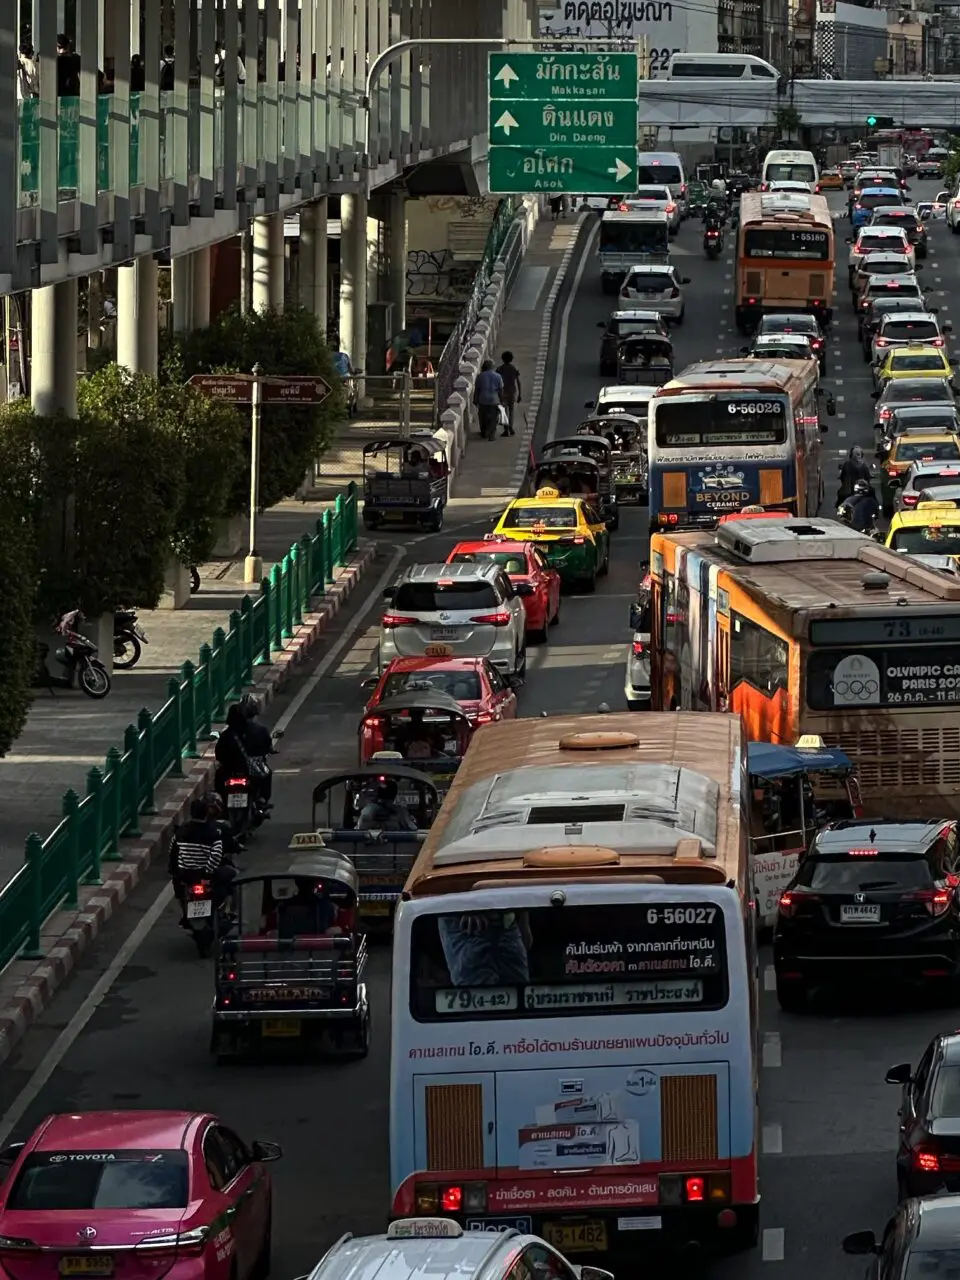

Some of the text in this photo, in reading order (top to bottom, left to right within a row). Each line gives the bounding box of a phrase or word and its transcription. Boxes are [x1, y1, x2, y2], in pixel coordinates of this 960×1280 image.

[536, 56, 621, 80] มักกะสัน
[552, 86, 605, 95] Makkasan
[542, 104, 613, 127] ดินแดง
[550, 133, 606, 144] Din Daeng
[523, 149, 573, 174] อโศก
[535, 179, 563, 188] Asok
[727, 402, 781, 414] 6-56026
[696, 492, 750, 501] BEYOND
[887, 666, 942, 678] OLYMPIC
[902, 679, 937, 689] PARIS
[887, 693, 901, 702] 26
[296, 837, 318, 845] TAXI
[646, 908, 717, 925] 6-56027
[565, 936, 715, 956] คันในร่มผ้า จากกลากที่ขาหนีบ
[689, 955, 716, 969] โอ.ดี.
[469, 1041, 499, 1057] โอ.ดี.
[503, 1030, 729, 1055] หาซื้อได้ตามร้านขายยาแผนปัจจุบันทั่วไป
[547, 1186, 576, 1198] ลดคัน
